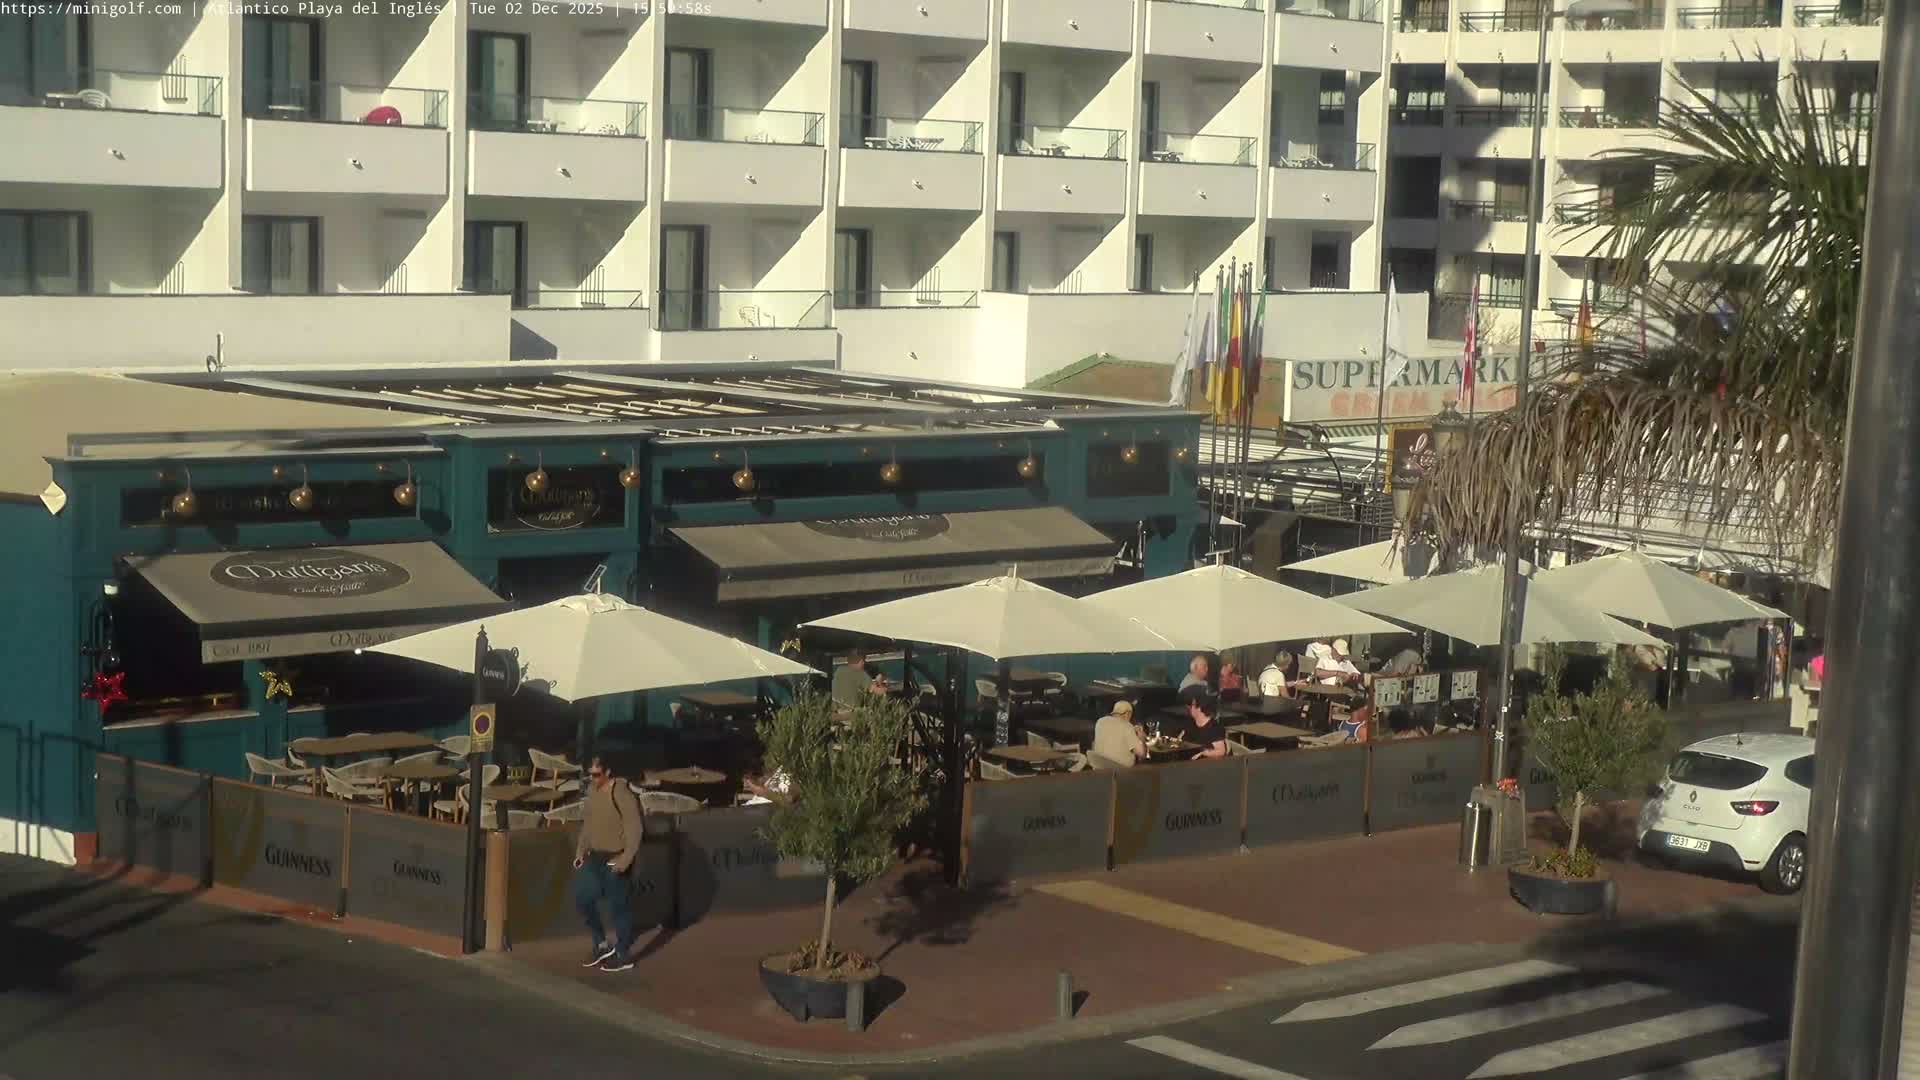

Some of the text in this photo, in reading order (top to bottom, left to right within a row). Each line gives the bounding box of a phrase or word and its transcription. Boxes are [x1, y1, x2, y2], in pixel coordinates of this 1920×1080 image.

[225, 561, 387, 580] Mulligan's
[1164, 806, 1223, 832] GUINNESS
[264, 843, 332, 878] GUINNESS
[393, 859, 441, 886] GUINNESS
